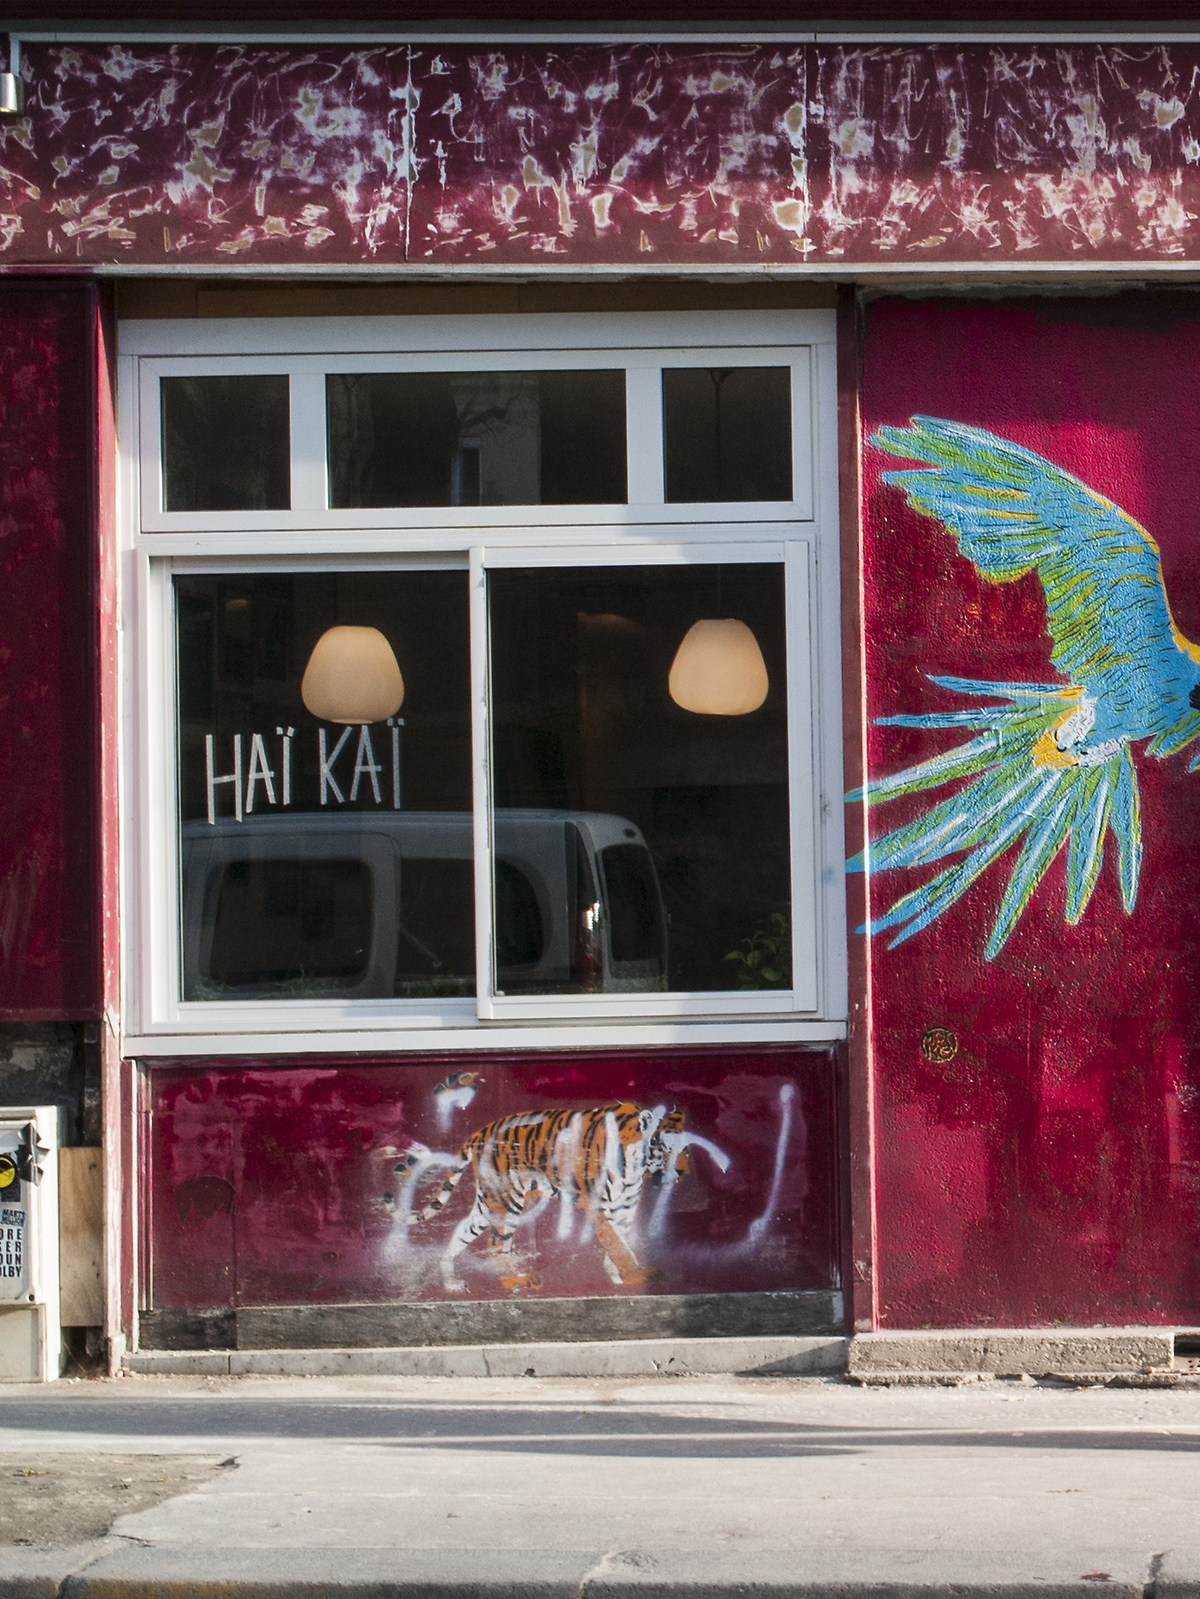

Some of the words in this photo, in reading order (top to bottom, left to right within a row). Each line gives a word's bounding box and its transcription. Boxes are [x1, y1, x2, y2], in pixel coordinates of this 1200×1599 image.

[206, 726, 295, 825] HAÏ
[318, 717, 405, 809] KAÏ
[0, 1241, 22, 1253] ER
[0, 1266, 22, 1278] LBY
